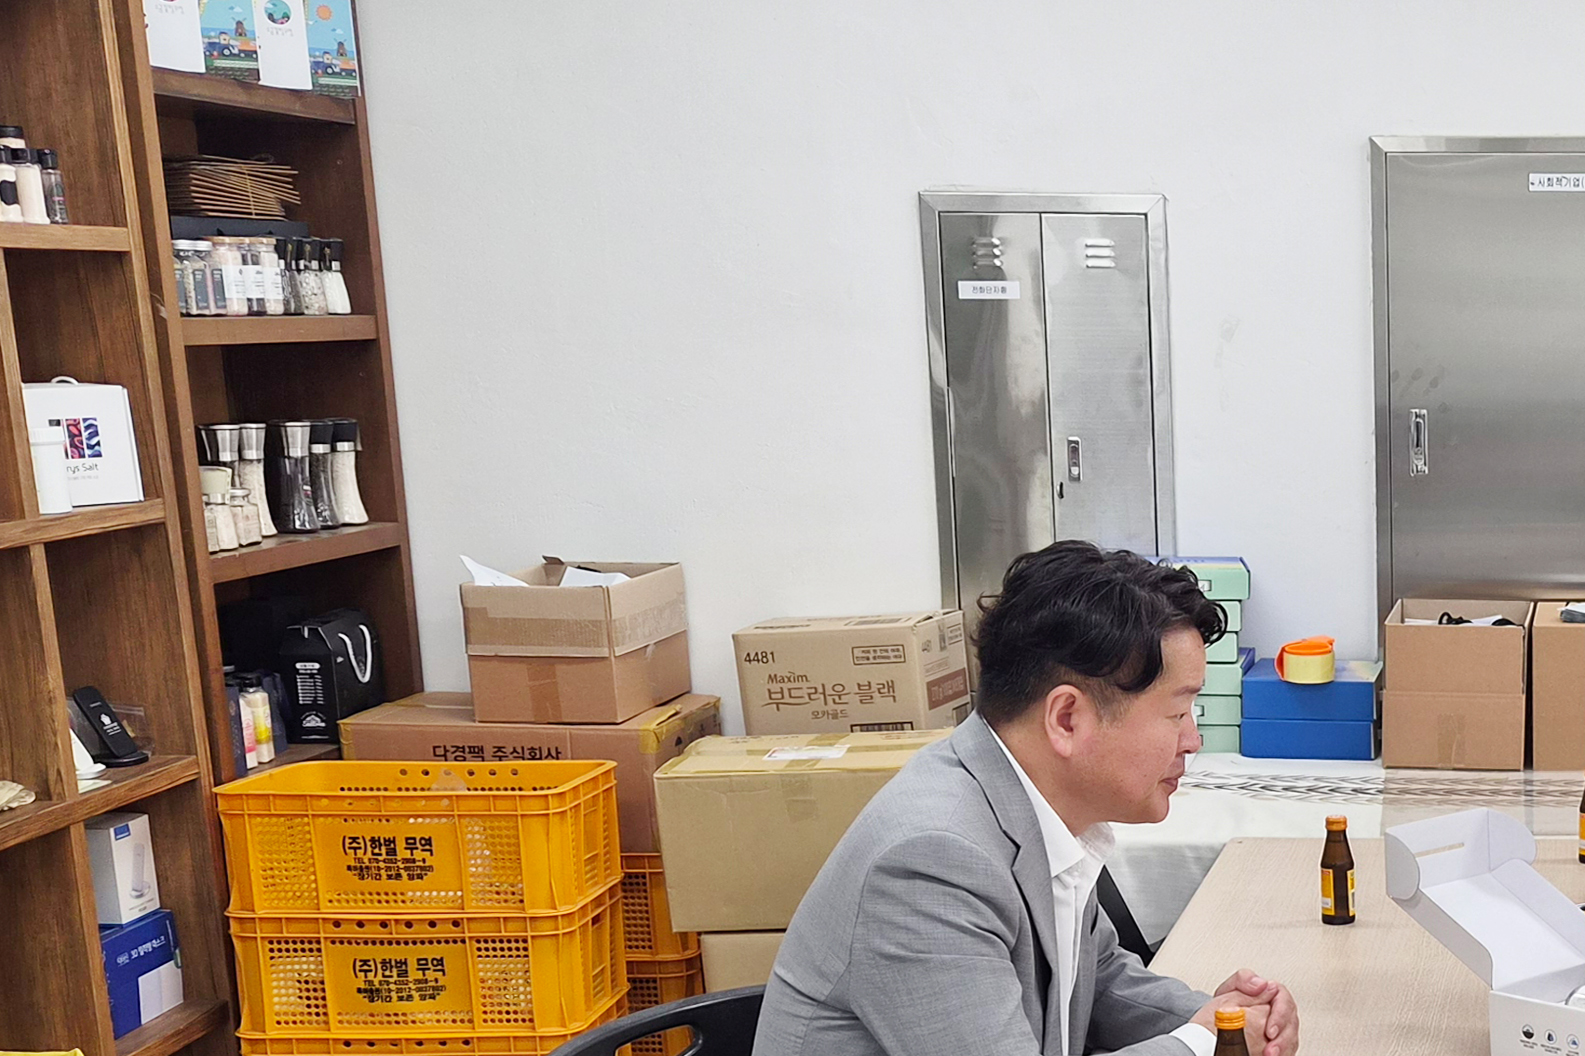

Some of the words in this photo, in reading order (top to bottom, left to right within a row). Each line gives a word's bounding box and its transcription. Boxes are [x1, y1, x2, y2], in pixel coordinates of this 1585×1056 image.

[82, 463, 99, 472] Salt
[744, 651, 776, 665] 4481
[767, 671, 810, 685] Maxim
[761, 683, 852, 712] 부드러운
[853, 679, 898, 704] 블랙
[811, 709, 851, 721] 모카골드
[432, 744, 486, 762] 다경팩
[491, 745, 562, 762] 주식회사
[341, 835, 398, 857] (주)한벌
[403, 836, 434, 857] 무역
[352, 957, 409, 979] (주)한벌
[415, 956, 446, 977] 무역
